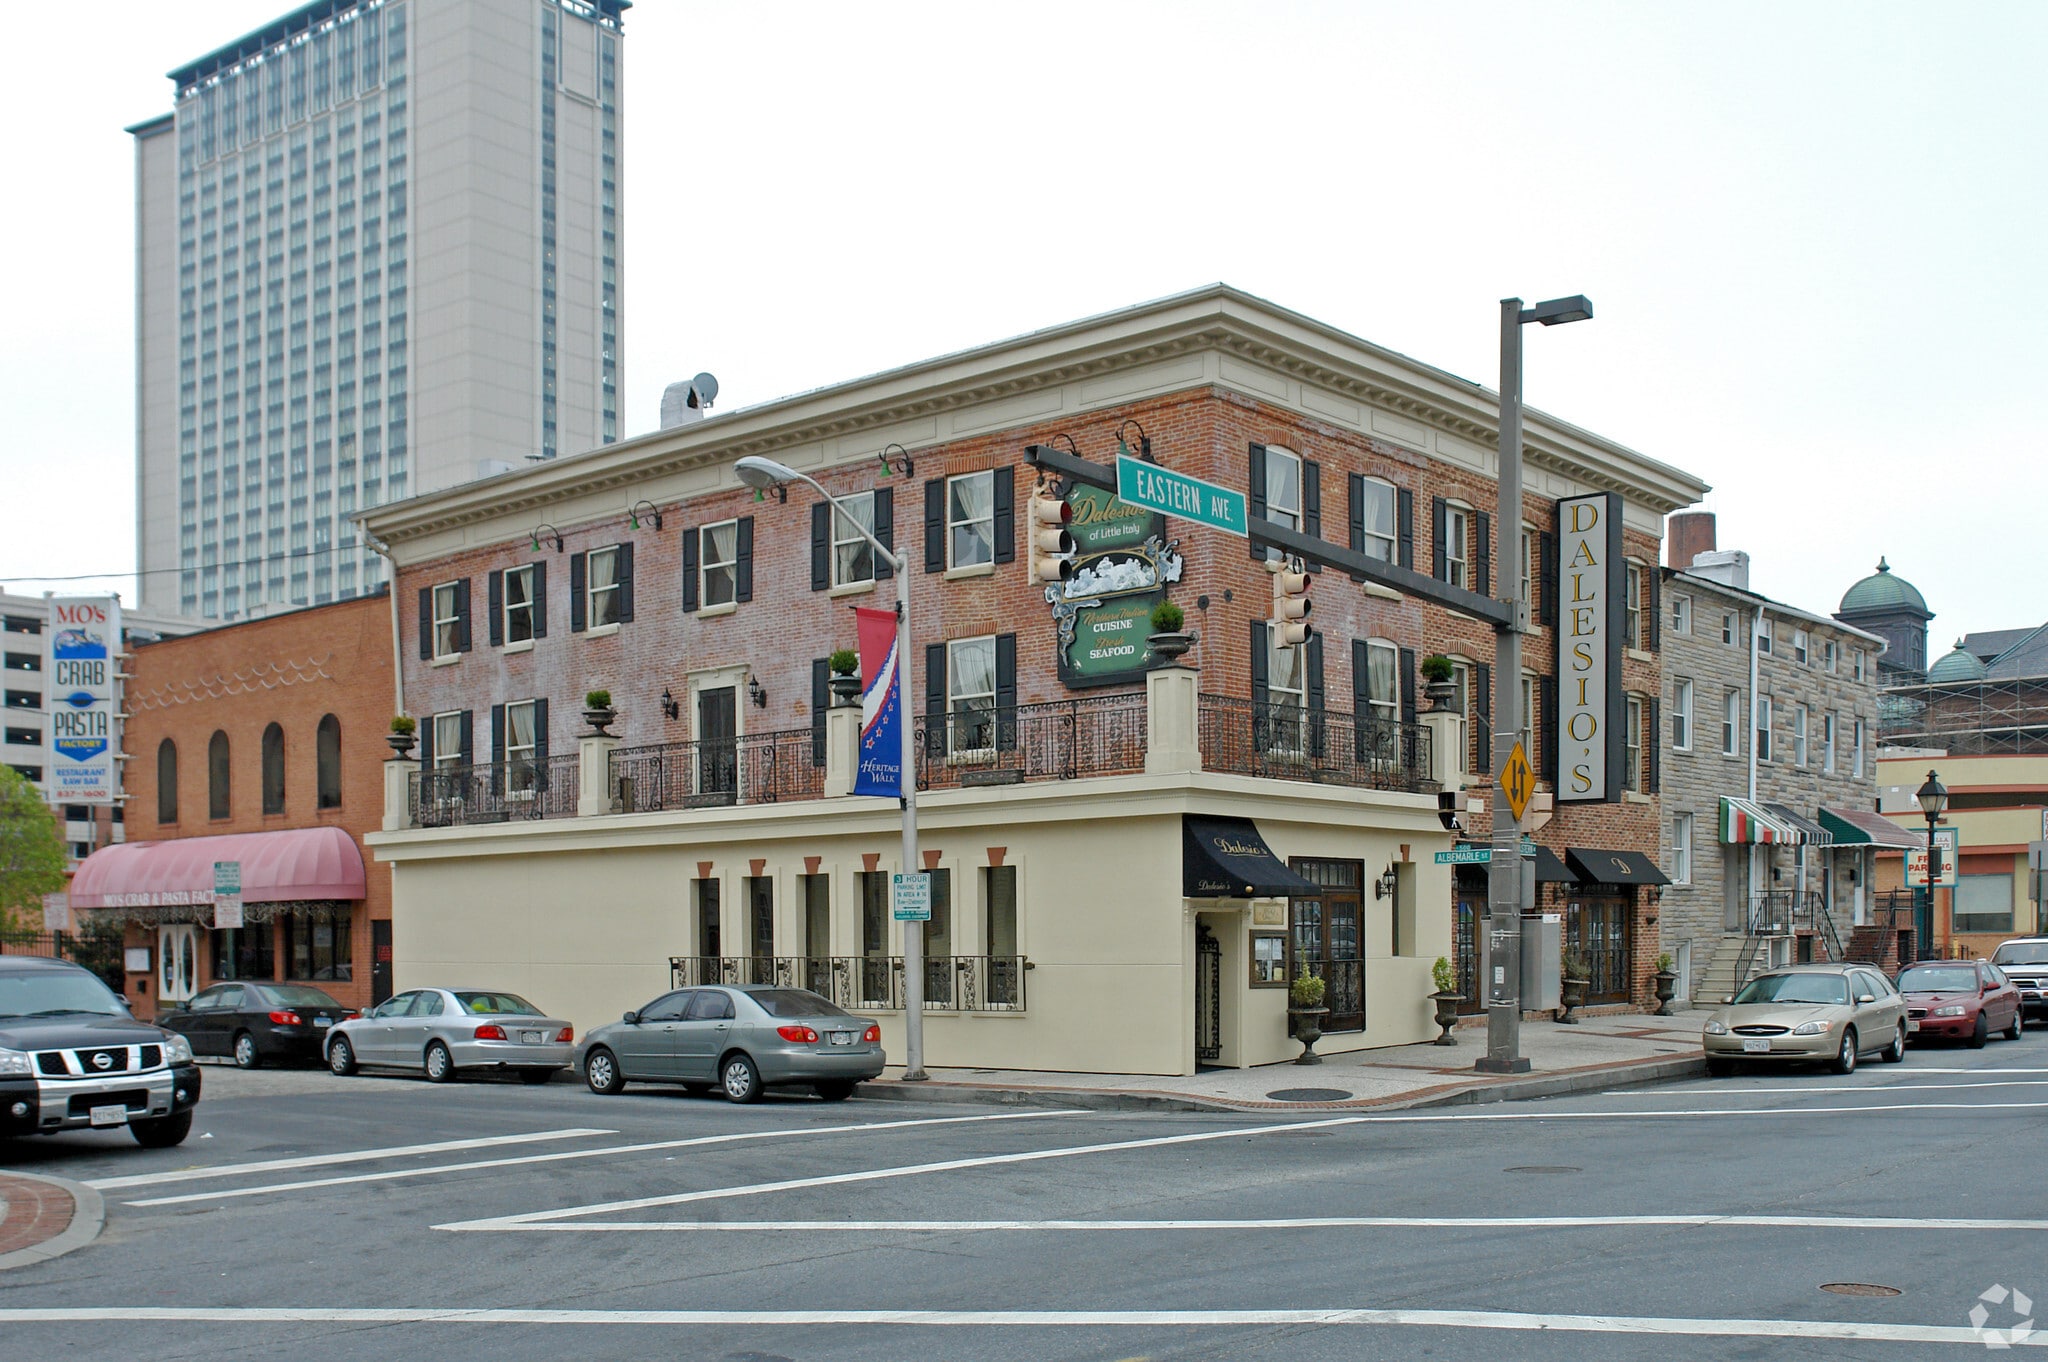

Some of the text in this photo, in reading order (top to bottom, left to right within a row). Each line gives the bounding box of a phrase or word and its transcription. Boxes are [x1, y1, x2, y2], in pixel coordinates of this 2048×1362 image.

[1137, 470, 1201, 515] EASTERN
[1071, 495, 1147, 526] Dalesios
[1089, 524, 1140, 541] of Little Italy
[1093, 619, 1133, 633] CUISINE
[1095, 635, 1125, 649] Fresh
[1568, 503, 1599, 794] DALESIO'S
[1089, 645, 1135, 659] SEAFOOD
[57, 660, 105, 686] CRAB
[54, 711, 107, 736] PASTA
[59, 740, 102, 748] FACTORY
[56, 768, 106, 777] RESTAURANT
[62, 777, 99, 785] RAW BAR
[1436, 851, 1480, 864] ALBEMARLE
[906, 875, 928, 883] HOUR
[125, 893, 150, 907] CRAB
[152, 891, 160, 905] &
[161, 890, 190, 905] PASTA
[191, 889, 216, 903] FACT
